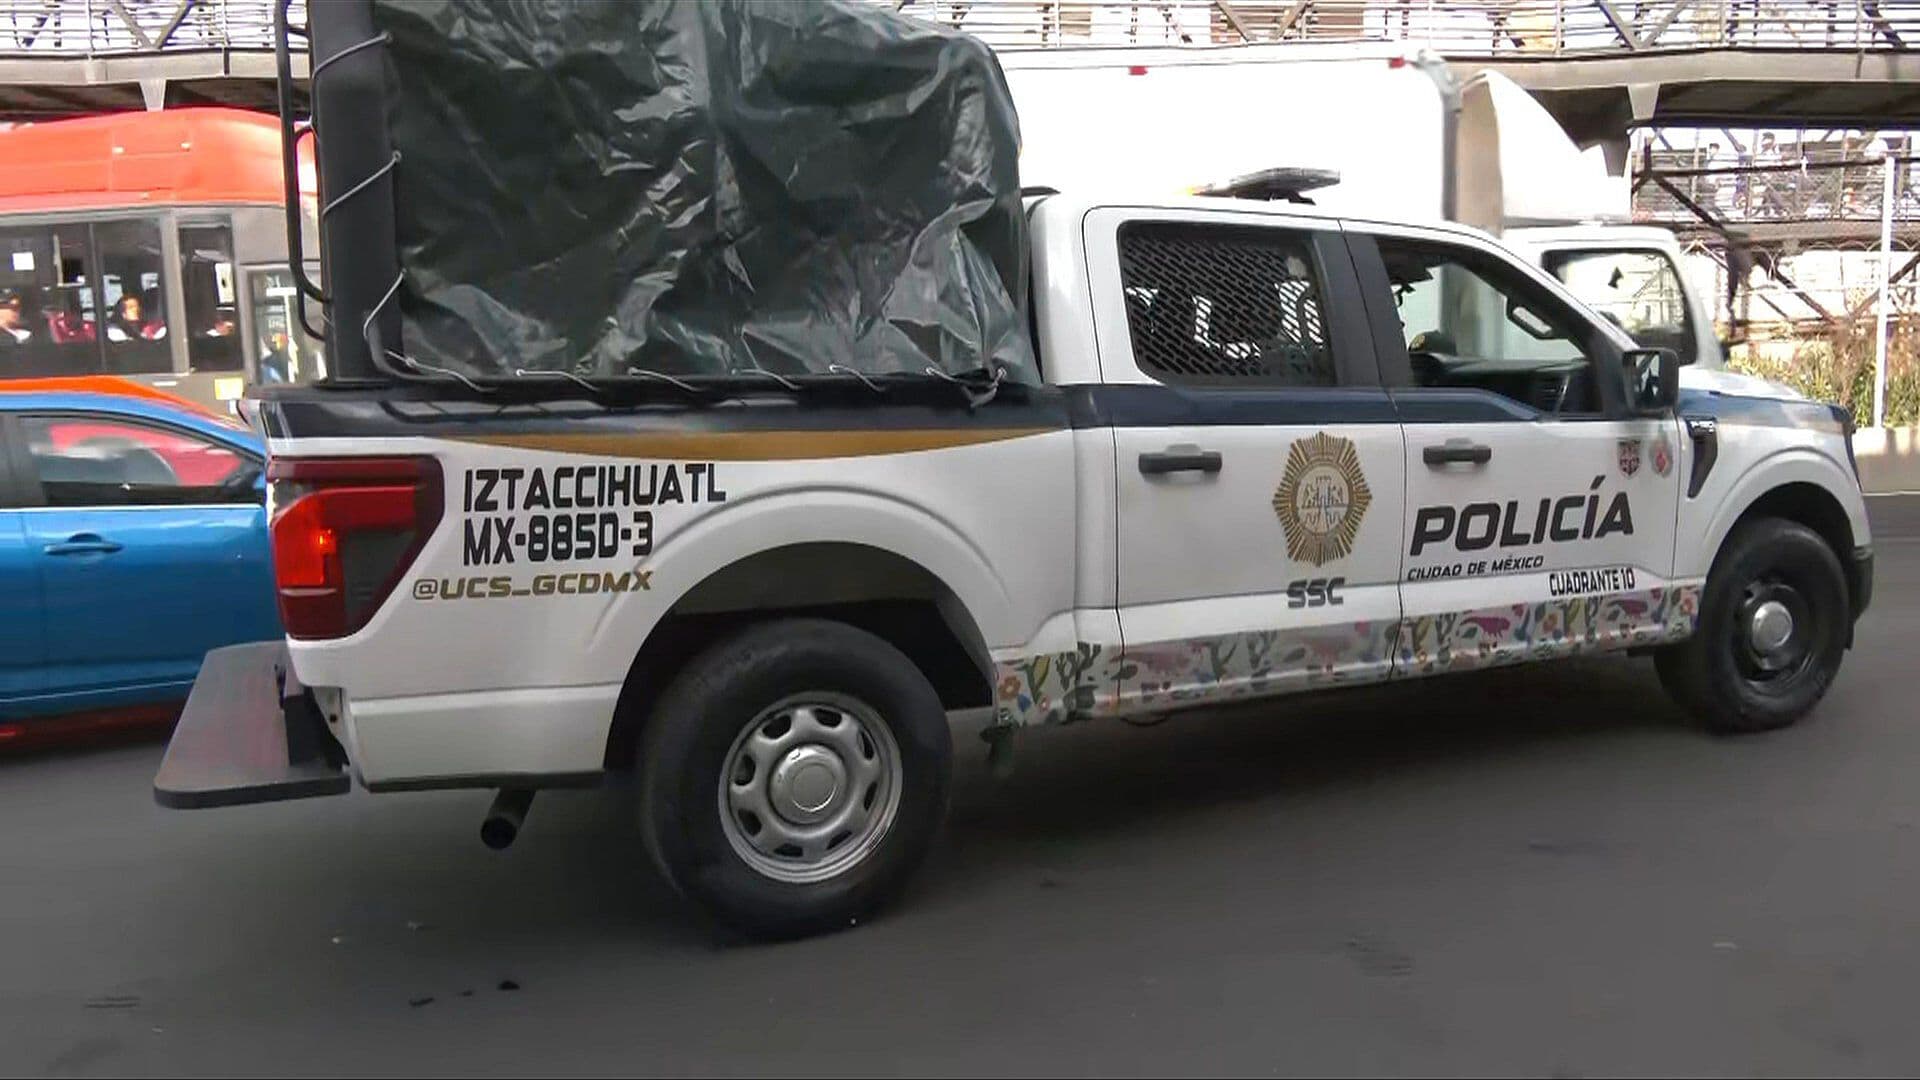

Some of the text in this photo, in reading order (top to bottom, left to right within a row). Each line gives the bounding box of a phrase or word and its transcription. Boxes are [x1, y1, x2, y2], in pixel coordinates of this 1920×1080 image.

[463, 463, 727, 512] IZTACCIHUATL
[1409, 475, 1634, 556] POLICÍA
[1407, 553, 1544, 580] CIUDAD DE MÉXICO
[1549, 567, 1635, 596] CUADRANTE 10
[412, 570, 655, 600] @UCS_GCDMX
[1286, 576, 1345, 609] SSC
